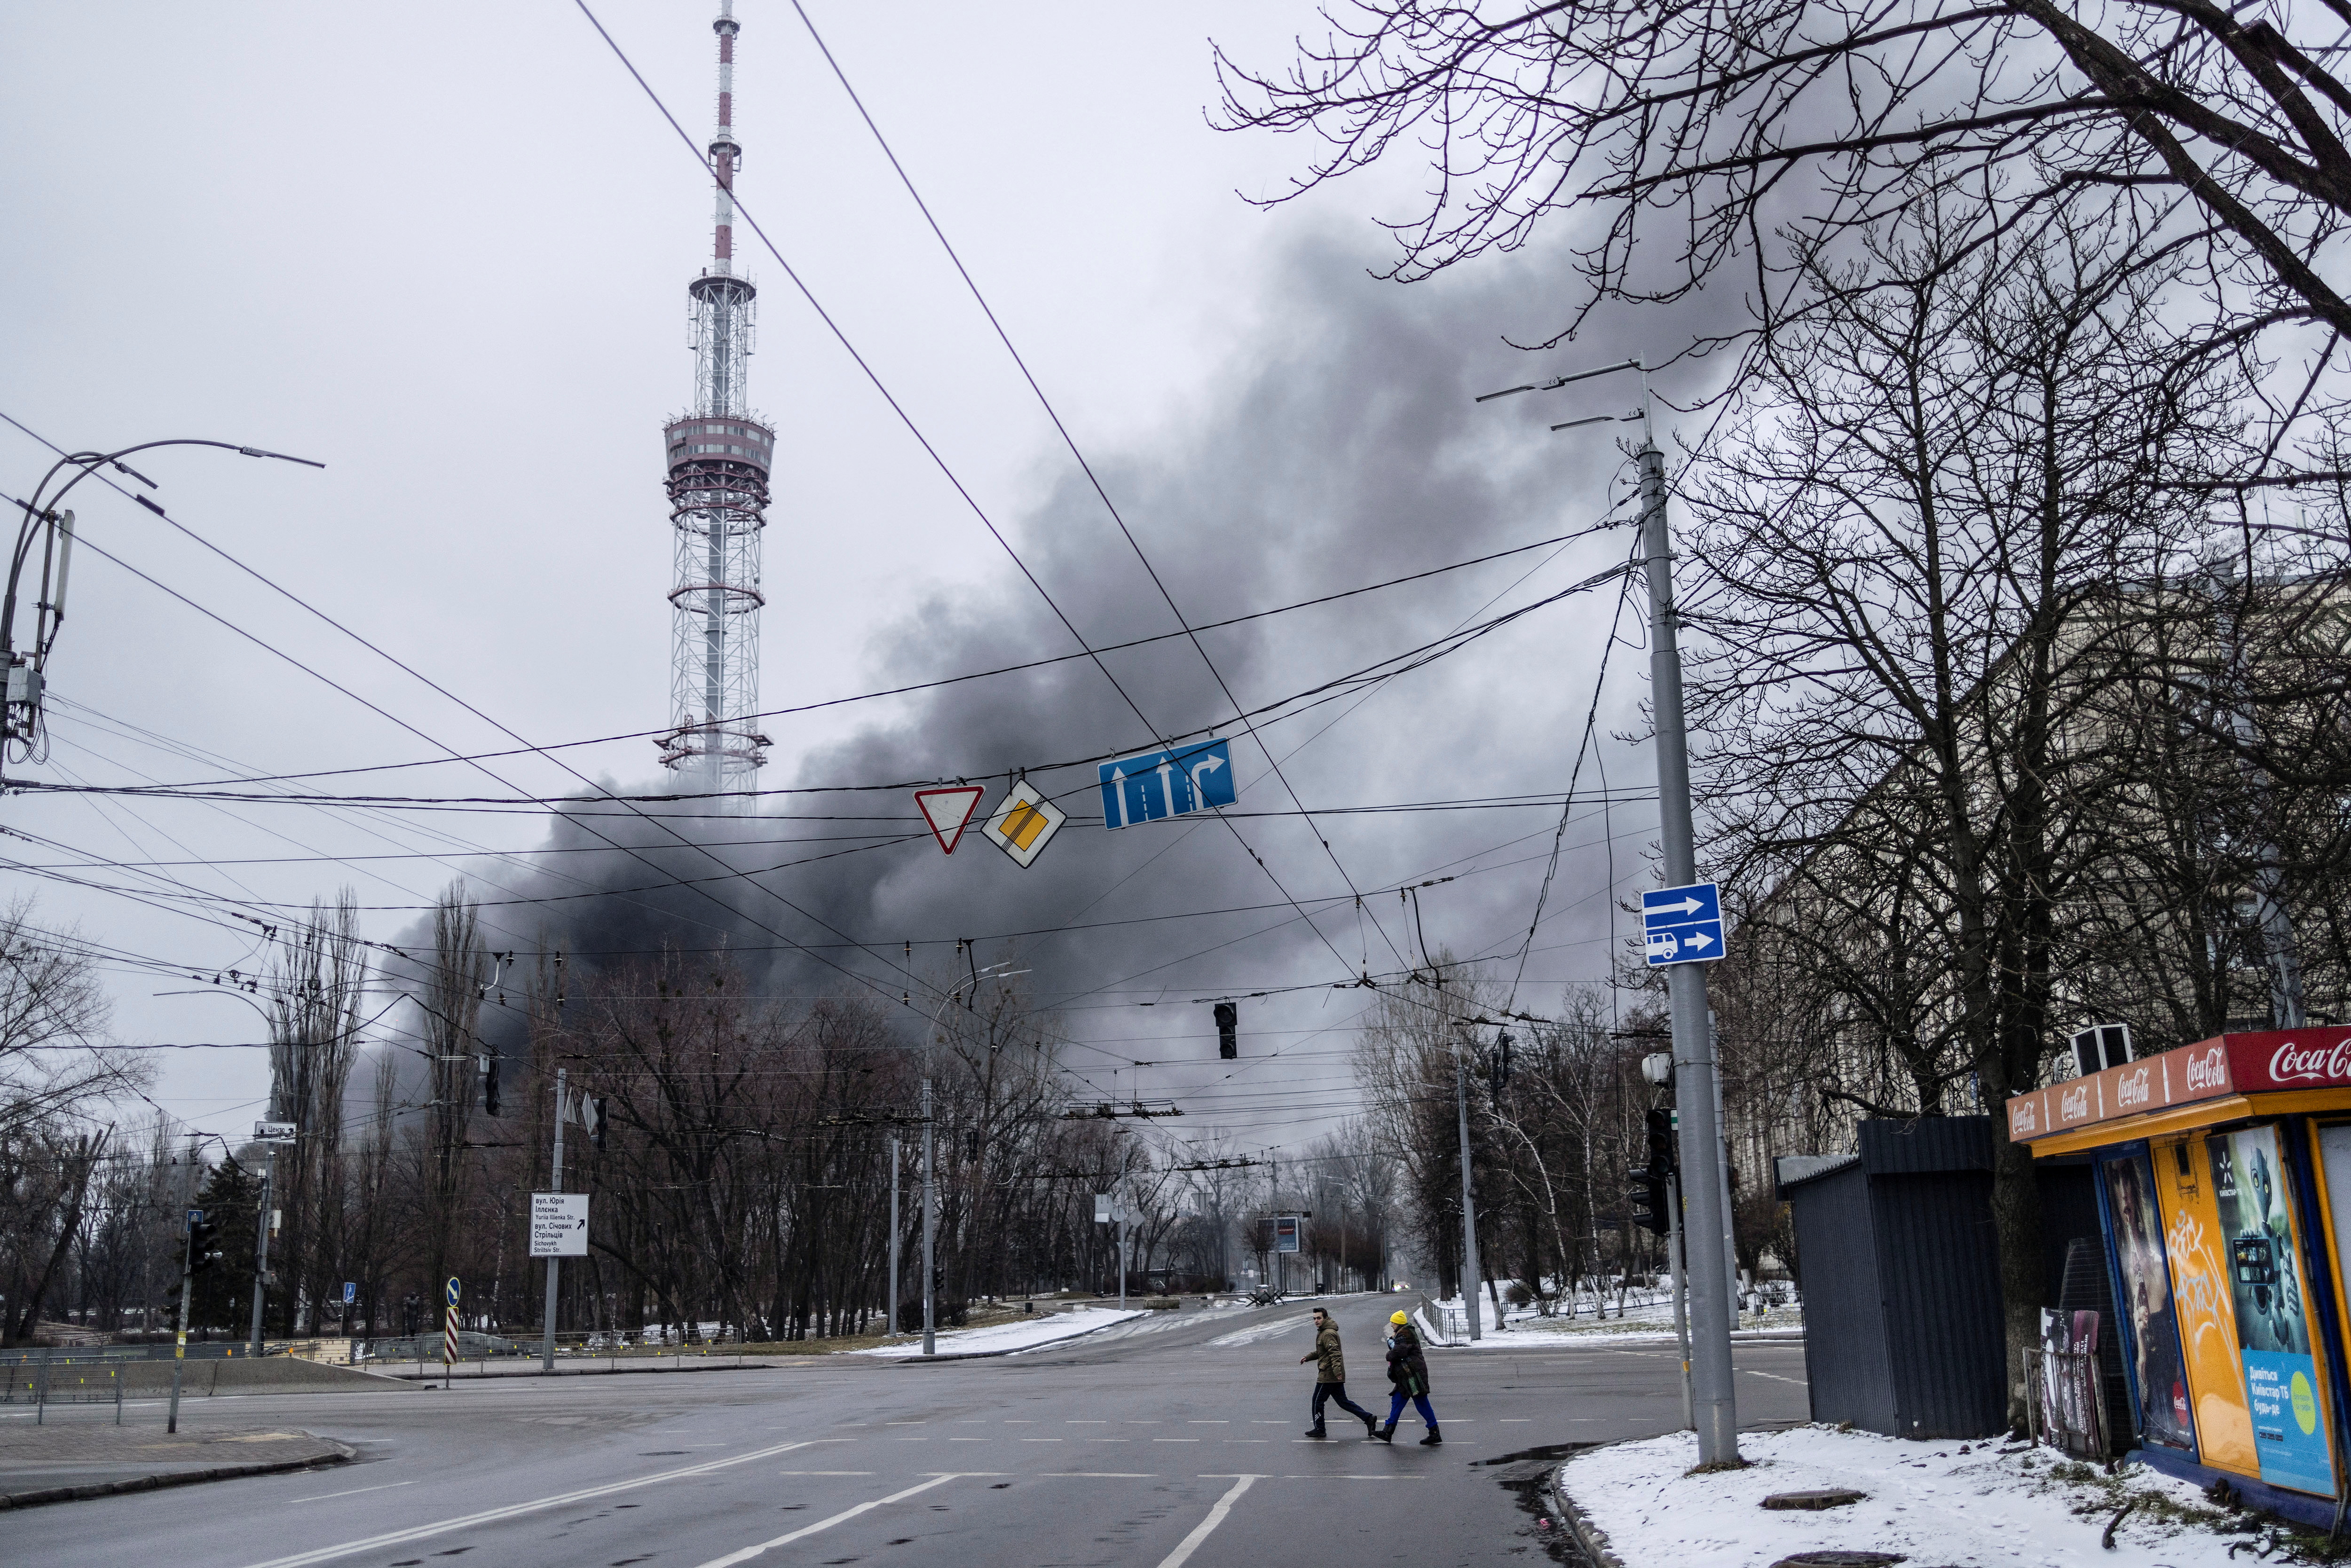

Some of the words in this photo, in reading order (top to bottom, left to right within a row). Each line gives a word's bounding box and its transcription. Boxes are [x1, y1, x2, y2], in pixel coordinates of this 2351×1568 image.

[2187, 1047, 2225, 1091] Coca-Cola
[2118, 1067, 2148, 1107] Coca-Cola
[2061, 1085, 2087, 1122] Coca-Cola
[2012, 1101, 2035, 1135] Coca-Cola
[550, 1197, 564, 1206] Юрія
[535, 1231, 563, 1239] Стрільців
[2249, 1366, 2278, 1381] Дивіться
[2251, 1383, 2280, 1401] Київстар
[2280, 1386, 2289, 1399] ТБ
[2254, 1399, 2280, 1416] будь-де
